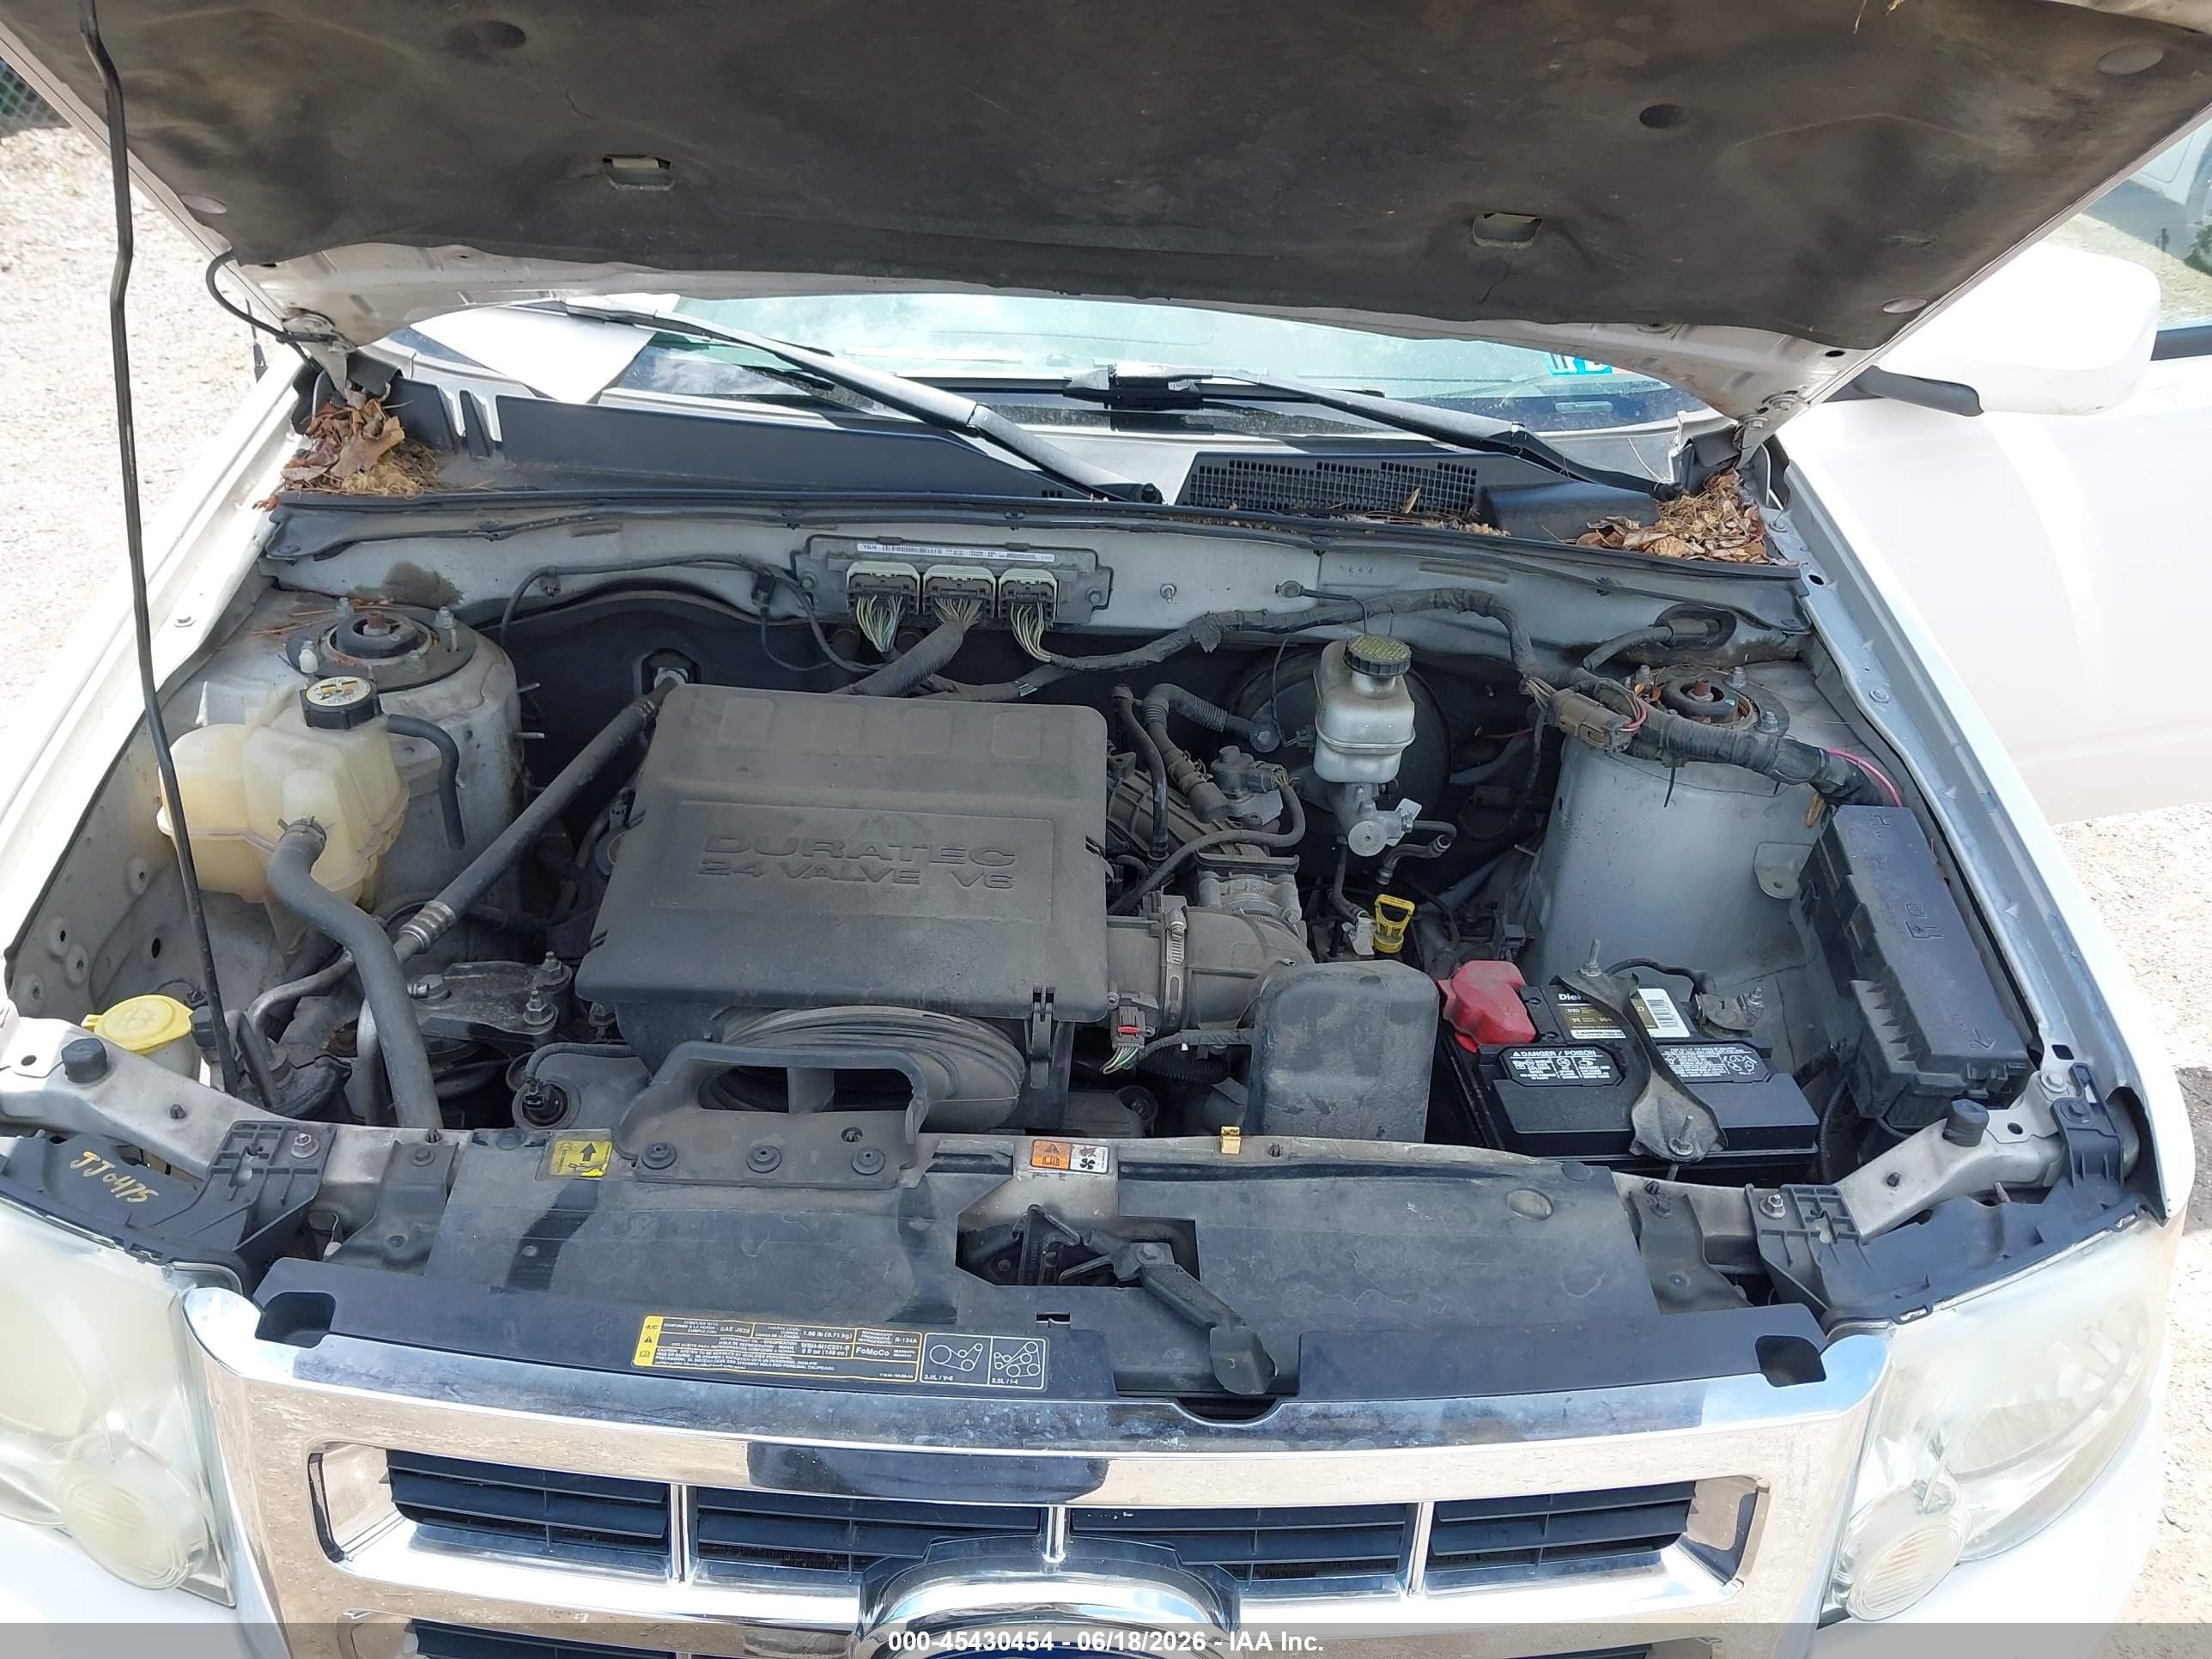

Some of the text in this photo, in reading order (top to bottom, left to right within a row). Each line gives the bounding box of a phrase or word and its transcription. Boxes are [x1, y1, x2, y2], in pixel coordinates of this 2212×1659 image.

[704, 834, 1015, 866] DURATEC
[699, 859, 1013, 889] 24 VALVE V6
[856, 1347, 890, 1357] FoMoCo
